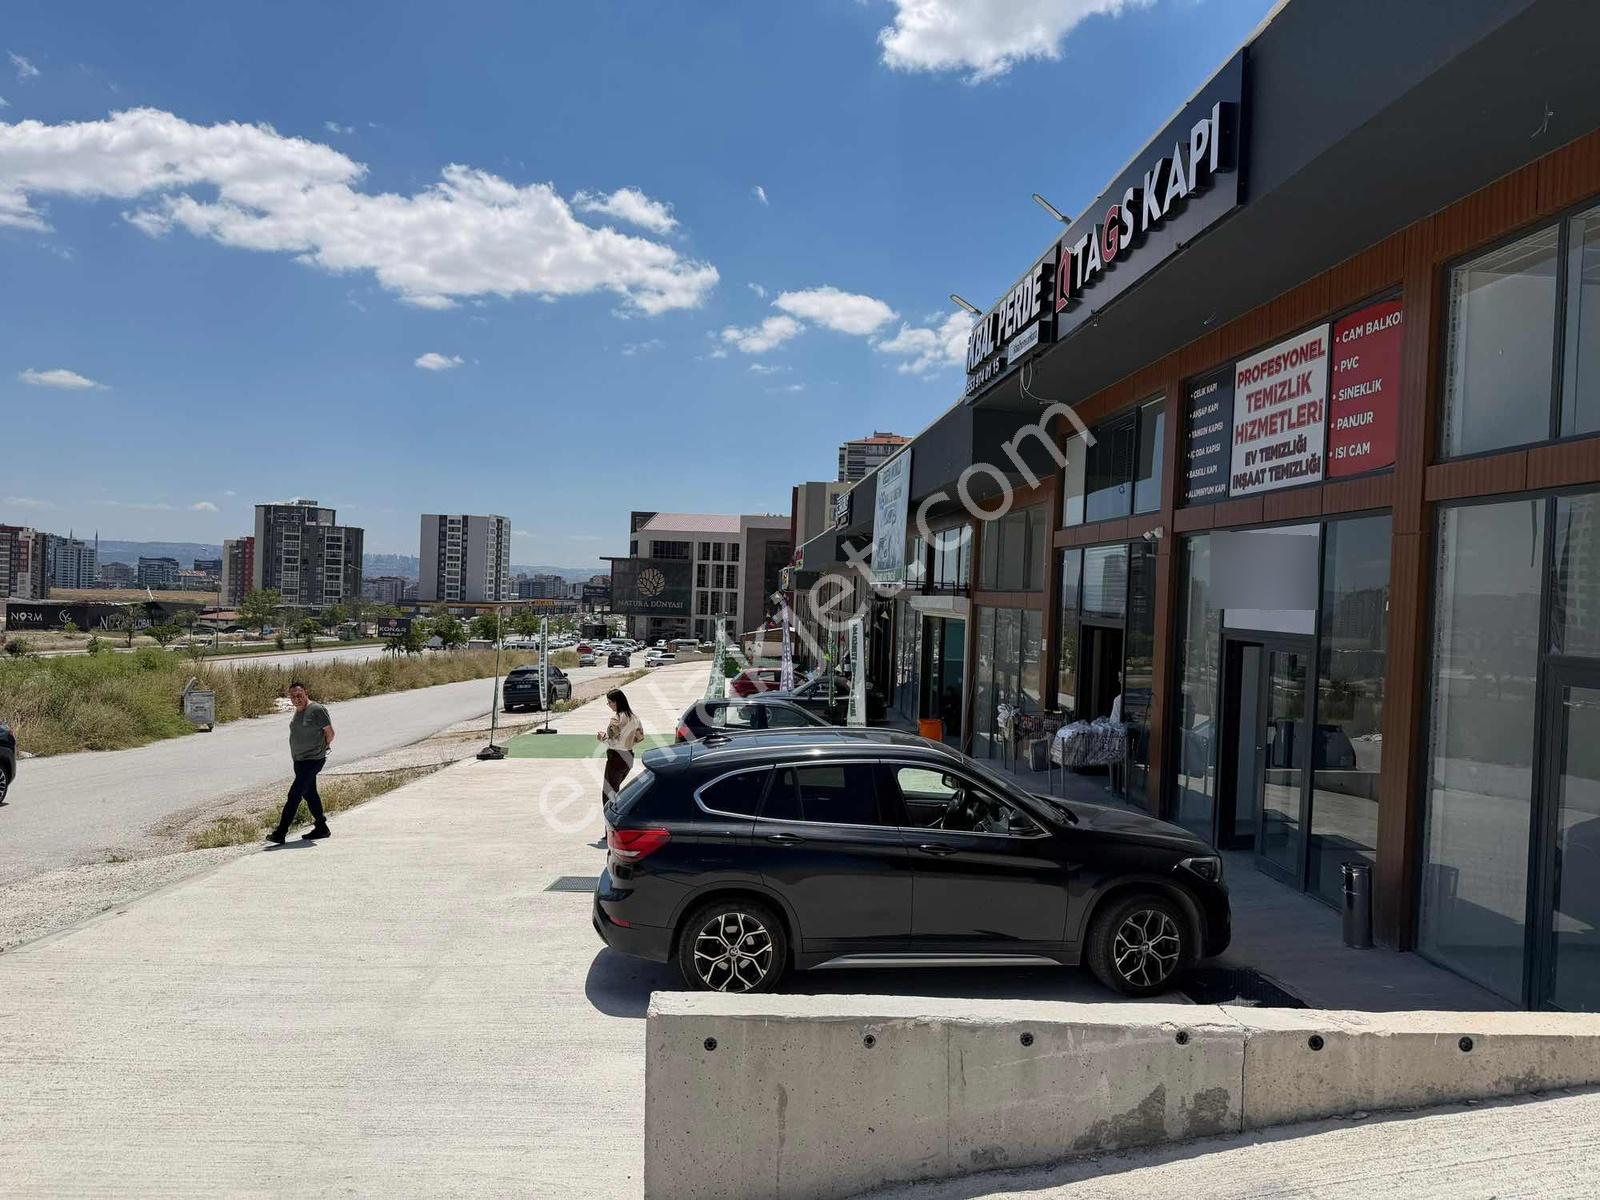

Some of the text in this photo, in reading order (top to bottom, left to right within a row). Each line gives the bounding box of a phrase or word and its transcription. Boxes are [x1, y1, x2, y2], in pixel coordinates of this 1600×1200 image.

[1073, 101, 1221, 290] TAGS KAPI
[997, 263, 1044, 347] PERDE
[1342, 310, 1403, 343] CAM BALKO
[1237, 338, 1325, 389] PROFESYONEL
[1340, 356, 1359, 372] PVC
[1246, 370, 1312, 413] TEMİZLİK
[1338, 379, 1382, 401] SİNEKLİK
[1235, 398, 1323, 446] HİZMETLERİ
[1337, 412, 1373, 430] PANJUR
[1245, 450, 1258, 467] EV
[1335, 441, 1370, 459] ISI CAM
[11, 612, 43, 621] NORM
